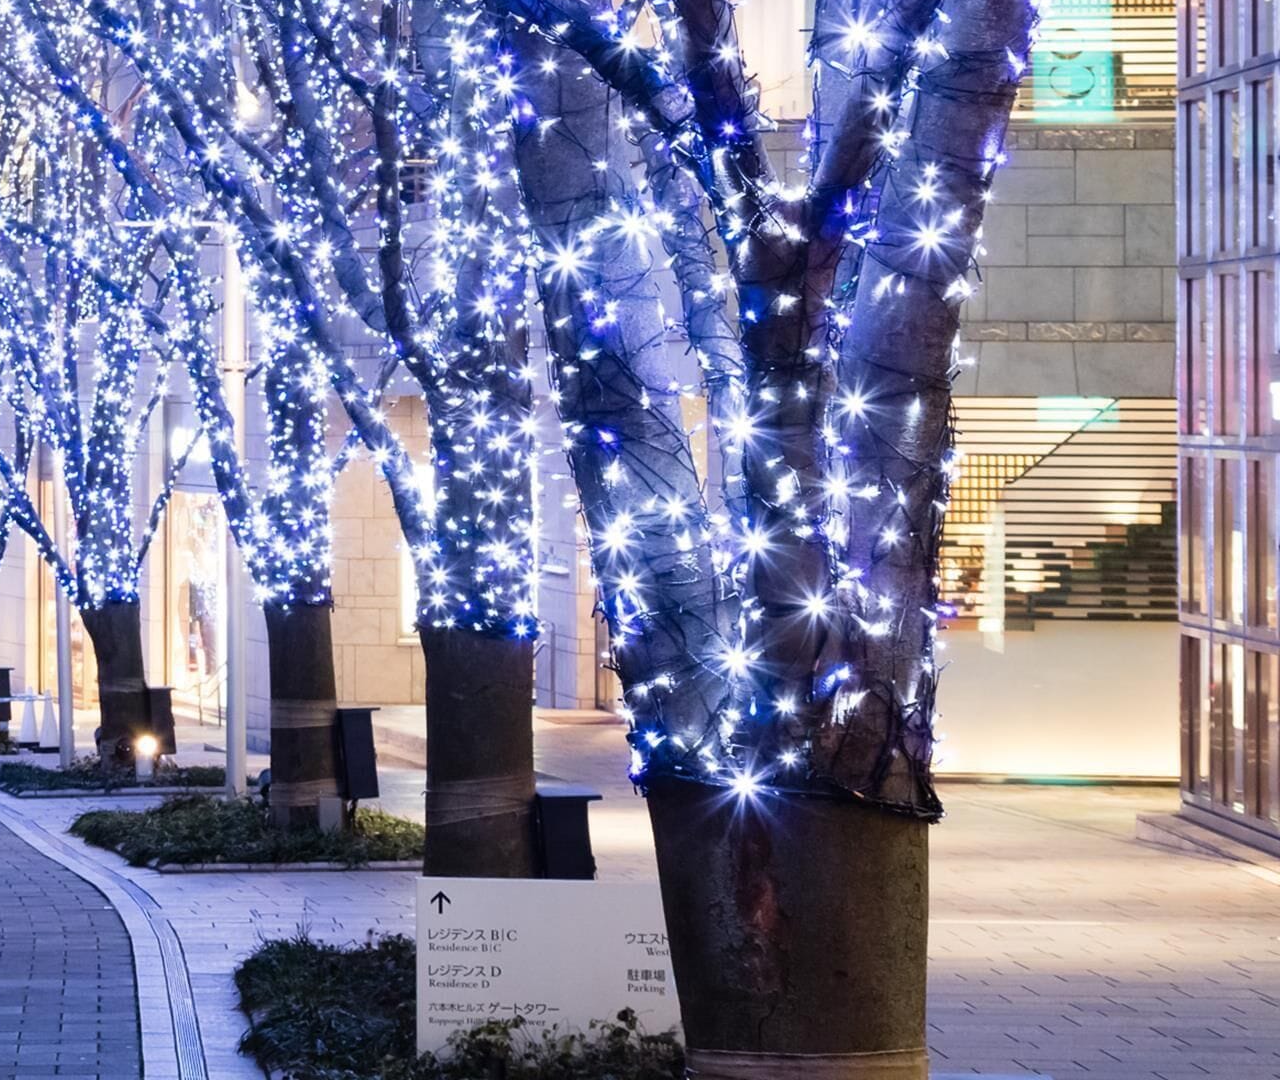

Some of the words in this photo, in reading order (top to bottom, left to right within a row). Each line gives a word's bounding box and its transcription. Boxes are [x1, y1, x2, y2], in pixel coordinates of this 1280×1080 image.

[427, 927, 486, 941] レジデンス
[624, 932, 669, 945] ウエスト
[428, 942, 478, 952] Residence
[645, 947, 670, 956] West
[427, 964, 486, 977] レジデンス
[491, 965, 502, 977] D
[627, 969, 666, 982] 駐車場
[428, 978, 478, 988] Residence
[481, 980, 490, 989] D
[627, 983, 666, 995] Parking
[428, 1002, 485, 1012] 六本木ヒルズ
[488, 1002, 560, 1016] ゲートタワー
